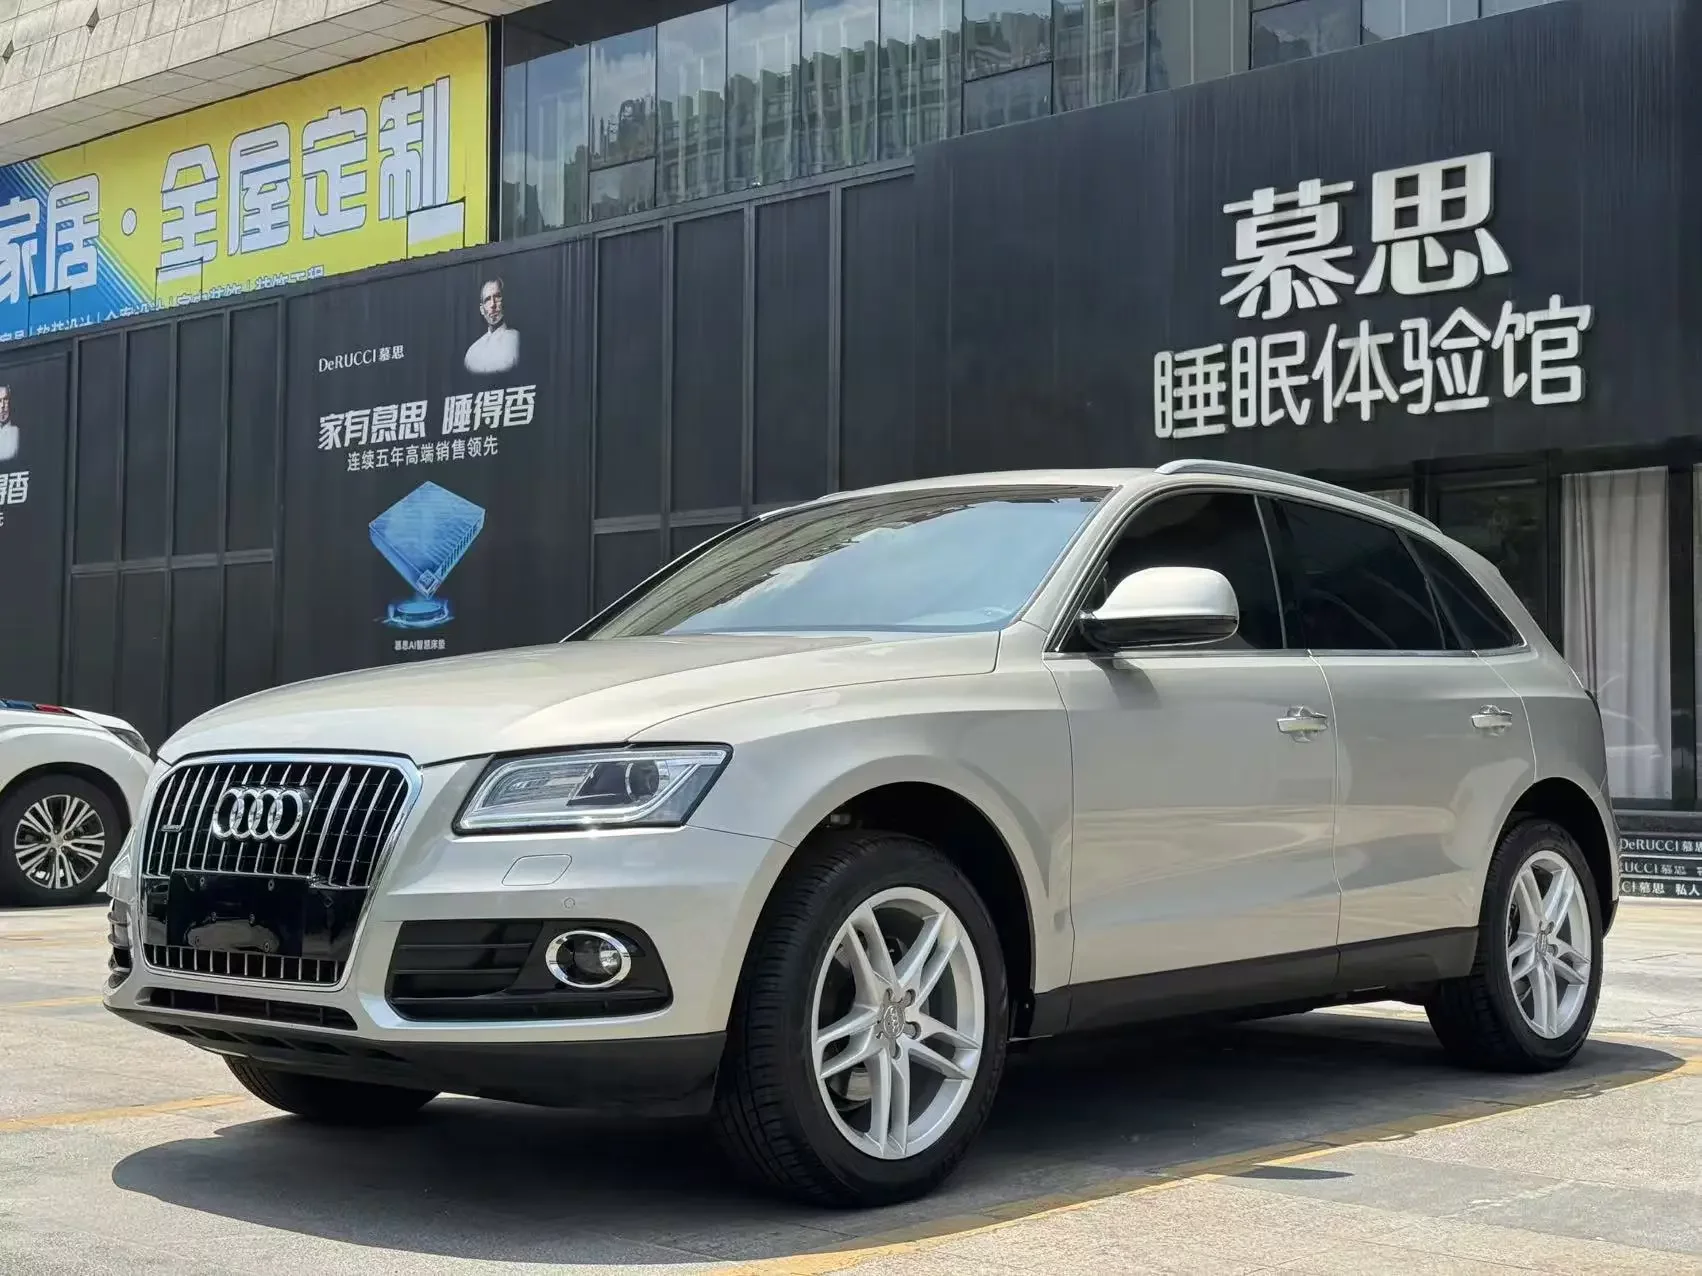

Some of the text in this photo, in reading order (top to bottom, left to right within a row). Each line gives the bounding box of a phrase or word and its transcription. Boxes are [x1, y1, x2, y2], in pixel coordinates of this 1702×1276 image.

[1220, 152, 1511, 319] 慕思
[318, 344, 405, 372] DeRUCCI 慕思
[1154, 294, 1593, 439] 睡眠体验馆
[318, 384, 536, 450] 家有慕思 睡得香
[347, 435, 498, 472] 连续五年高端销售领先
[1620, 838, 1679, 852] DeRUCCI
